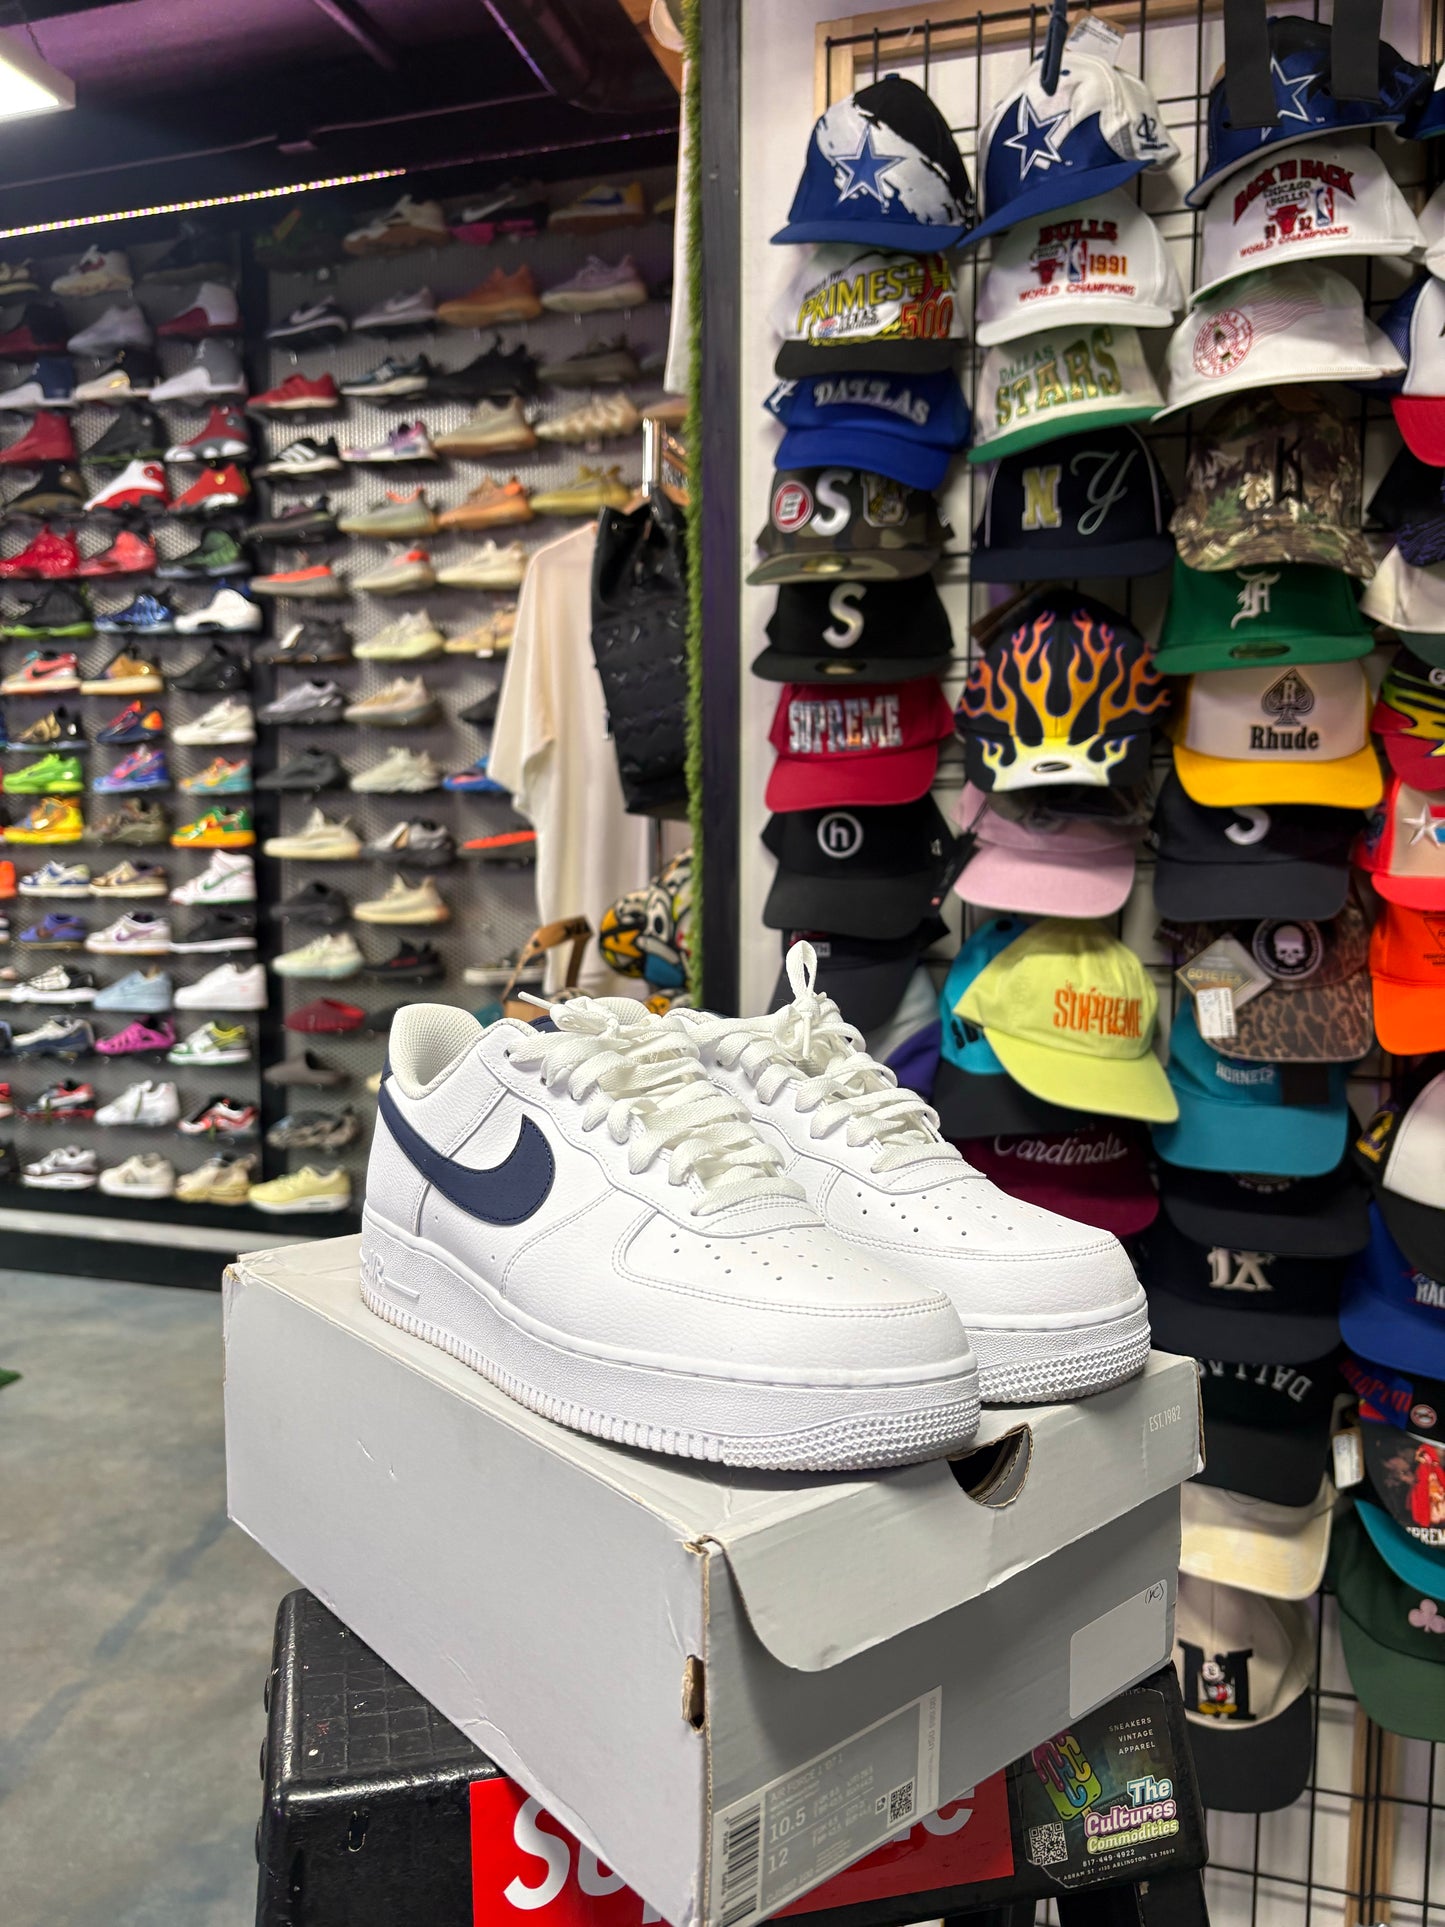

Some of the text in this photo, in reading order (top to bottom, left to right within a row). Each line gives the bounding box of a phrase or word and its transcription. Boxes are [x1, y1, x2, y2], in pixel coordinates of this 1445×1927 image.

[1039, 219, 1118, 246] BULLS
[1278, 226, 1349, 244] CHAMPIONS
[1090, 254, 1127, 276] 1991
[1019, 282, 1137, 302] WORLD CHAMPIONS
[901, 294, 954, 338] 500
[994, 323, 1122, 427] STARS
[813, 378, 931, 427] DALLAS
[810, 470, 854, 537] S
[1021, 464, 1063, 532] N
[822, 582, 868, 650] S
[788, 694, 903, 754] SUPREME
[1249, 724, 1320, 750] Rhude
[993, 1132, 1128, 1166] Cardinals
[1108, 1717, 1152, 1732] SNEAKERS
[1118, 1729, 1154, 1743] VINTAGE
[1118, 1741, 1156, 1756] APPAREL
[1127, 1775, 1173, 1807] The
[768, 1806, 807, 1844] 10.5
[1084, 1799, 1177, 1837] Cultures
[1087, 1819, 1179, 1854] Commodities
[767, 1847, 789, 1875] 12
